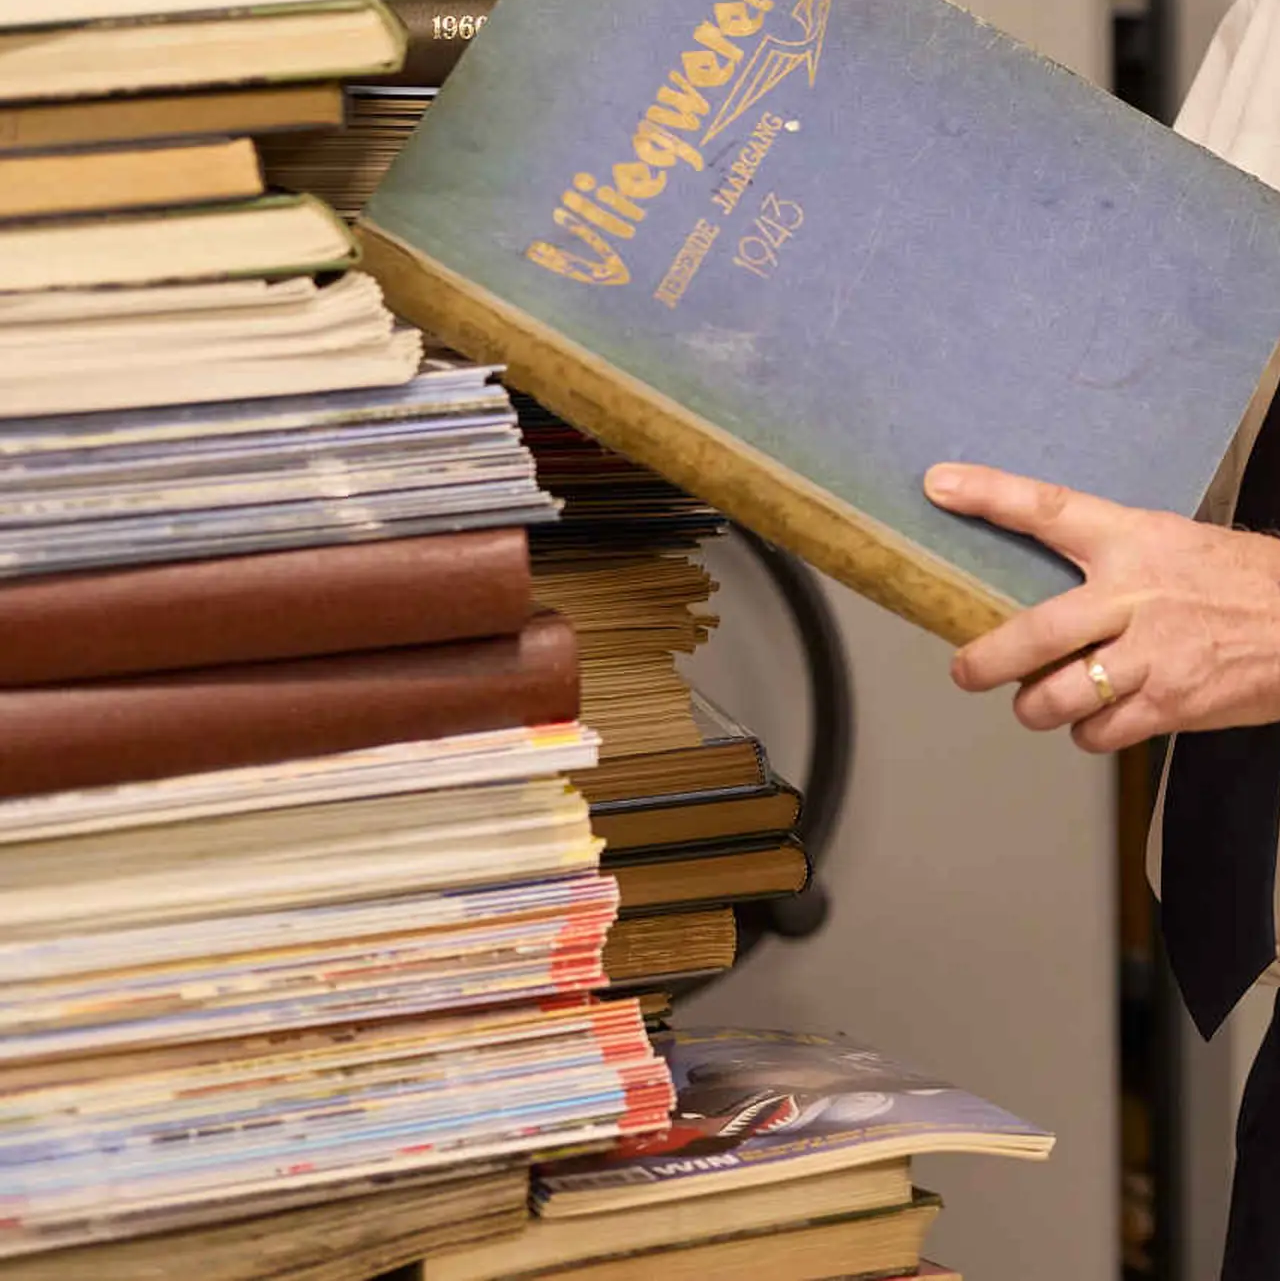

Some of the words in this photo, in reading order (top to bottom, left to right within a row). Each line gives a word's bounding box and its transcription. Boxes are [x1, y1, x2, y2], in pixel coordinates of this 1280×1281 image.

[710, 112, 783, 215] JAARGANG
[733, 191, 804, 278] 1943
[651, 1153, 740, 1176] WIN
